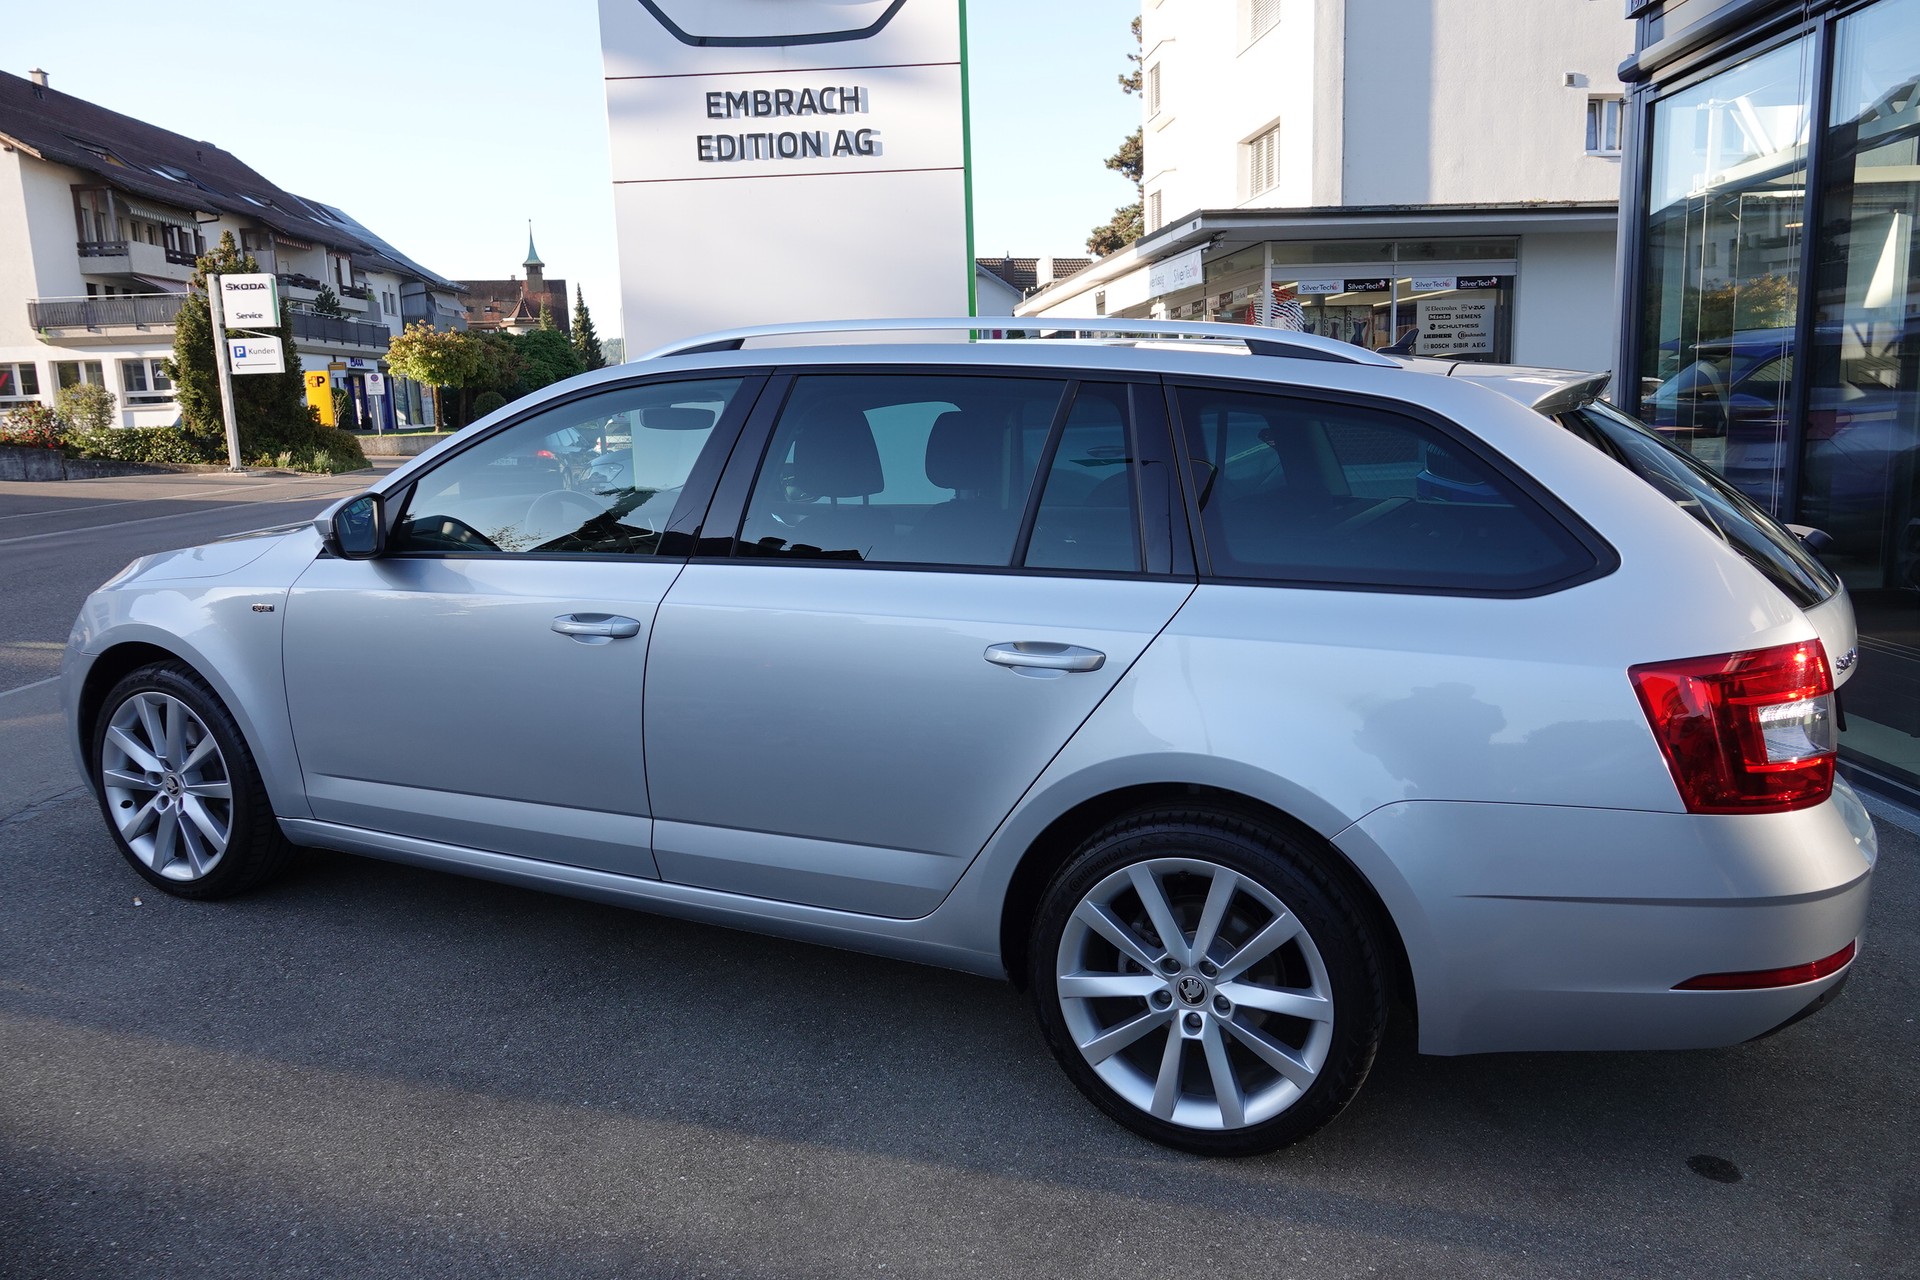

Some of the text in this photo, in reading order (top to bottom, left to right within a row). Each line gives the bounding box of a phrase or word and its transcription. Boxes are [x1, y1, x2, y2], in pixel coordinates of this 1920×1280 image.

[705, 86, 860, 118] EMBRACH
[696, 128, 874, 161] EDITION AG
[236, 311, 263, 320] Service
